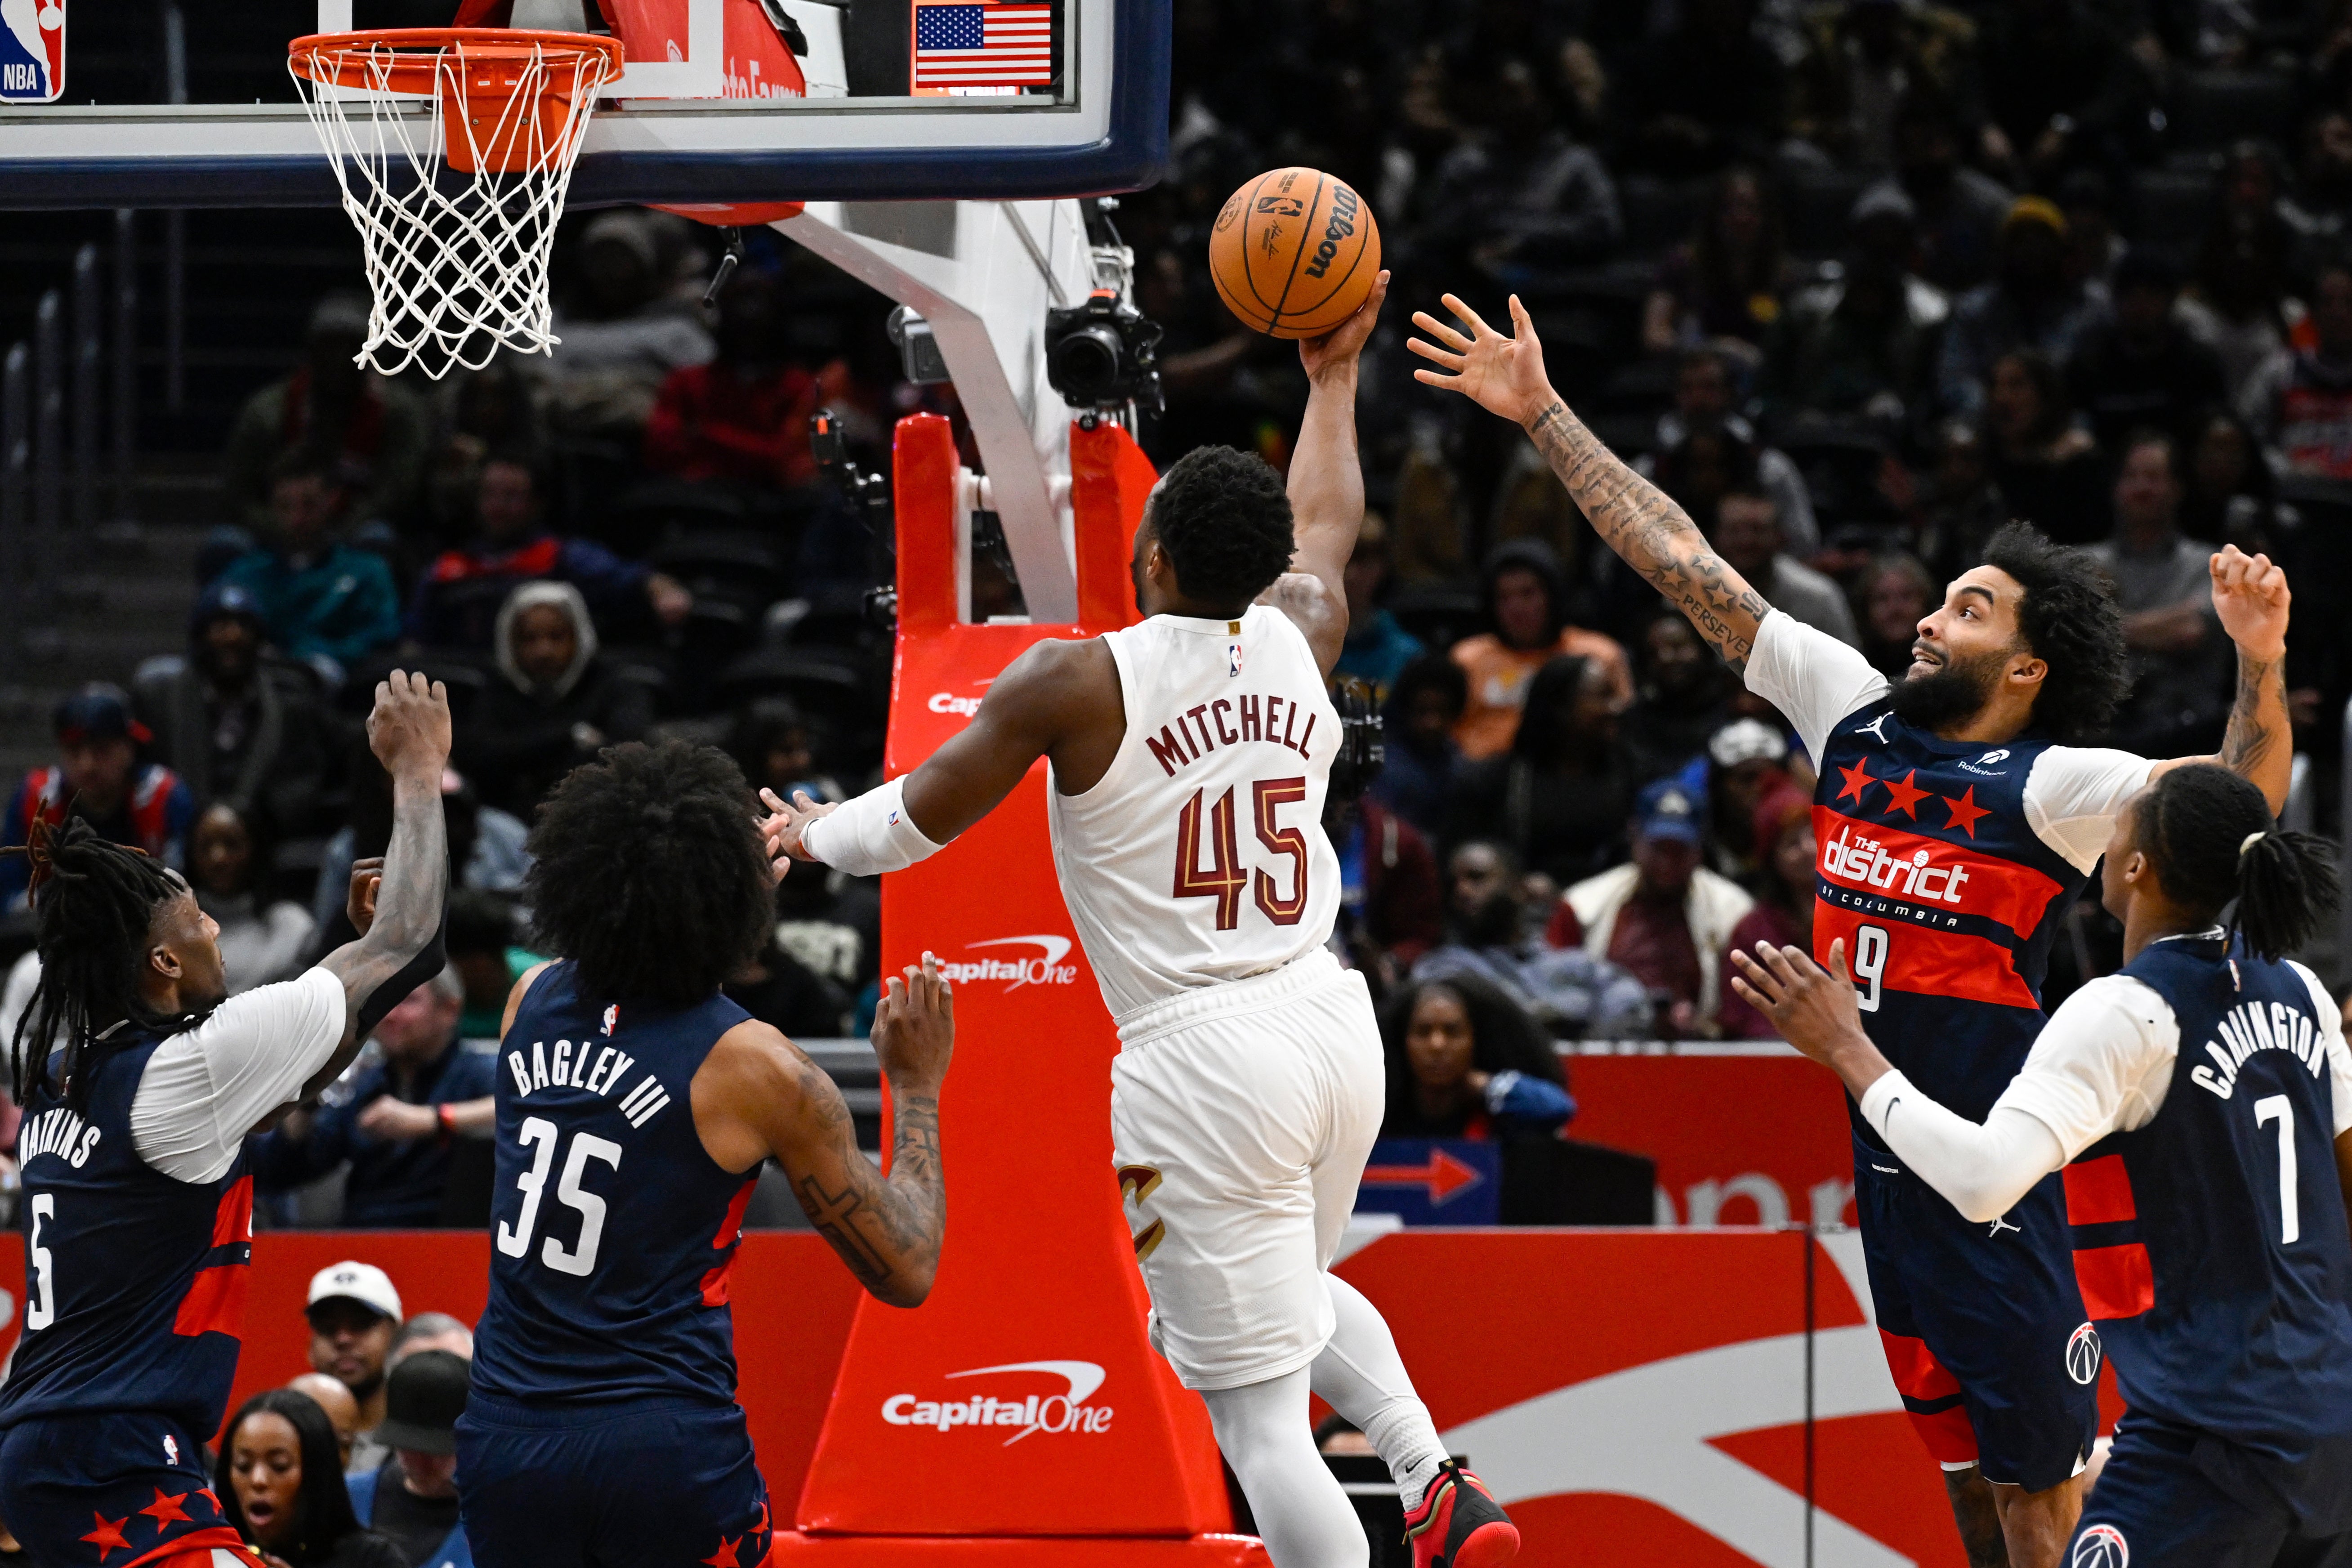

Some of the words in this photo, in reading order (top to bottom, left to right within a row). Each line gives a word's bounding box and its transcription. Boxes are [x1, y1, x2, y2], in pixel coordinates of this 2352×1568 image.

[4, 64, 37, 90] NBA
[1304, 184, 1358, 279] Wilson
[1145, 695, 1317, 778] MITCHELL
[1958, 761, 2008, 776] Robinhood
[1173, 776, 1308, 931] 45
[1823, 825, 1969, 903] district
[1855, 835, 1881, 852] THE
[1822, 885, 1833, 898] OF
[1841, 893, 1958, 927] COLUMBIA
[1854, 925, 1889, 1013] 9
[508, 1039, 635, 1098] BAGLEY
[618, 1074, 671, 1129] III
[2191, 1001, 2326, 1100] CARRINGTON
[497, 1116, 622, 1277] 35
[2254, 1094, 2299, 1245] 7
[27, 1193, 54, 1331] 5
